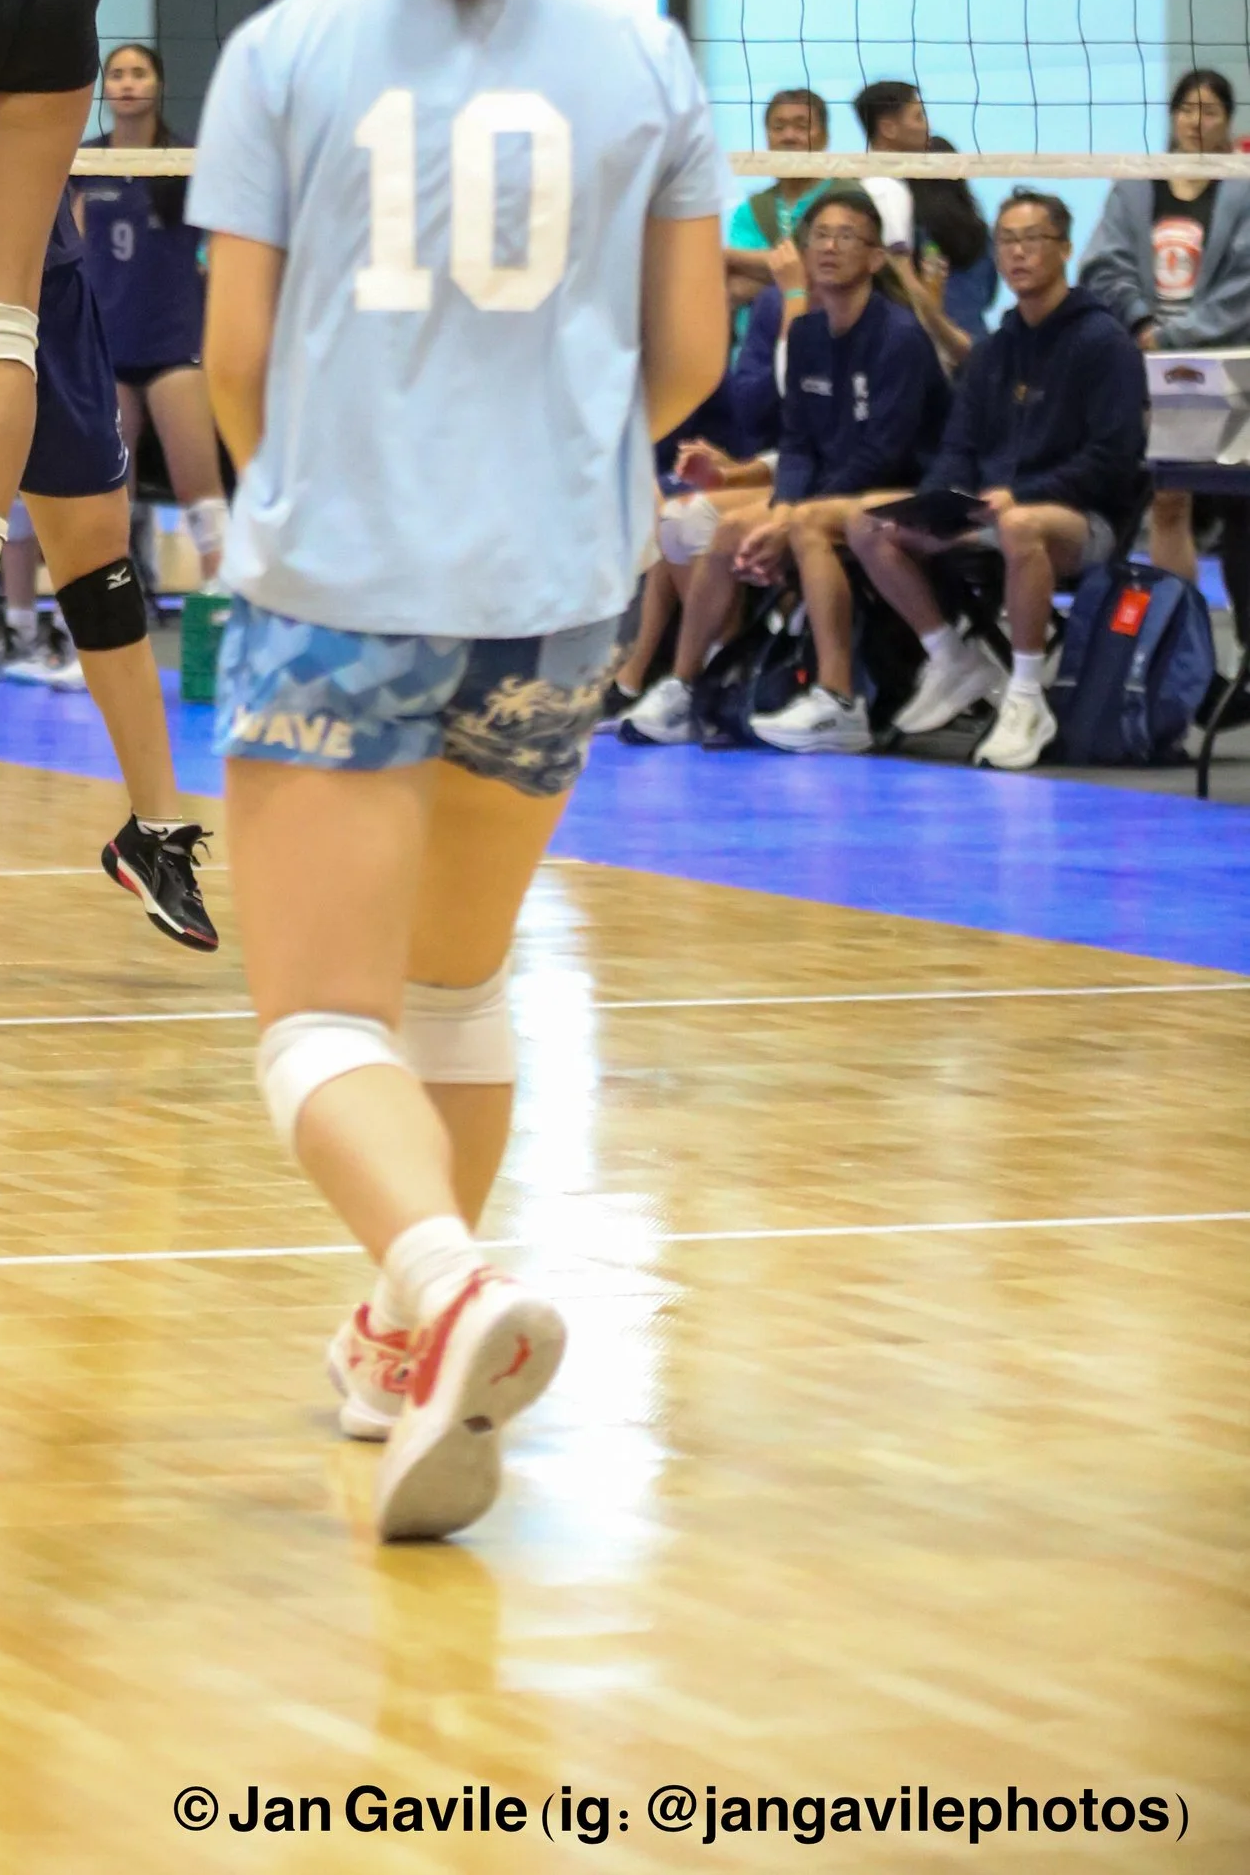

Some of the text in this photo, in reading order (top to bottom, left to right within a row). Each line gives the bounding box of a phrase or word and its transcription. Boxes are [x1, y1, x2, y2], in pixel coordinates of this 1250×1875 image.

[353, 87, 574, 312] 10
[111, 220, 135, 262] 9
[231, 704, 355, 759] WAVE
